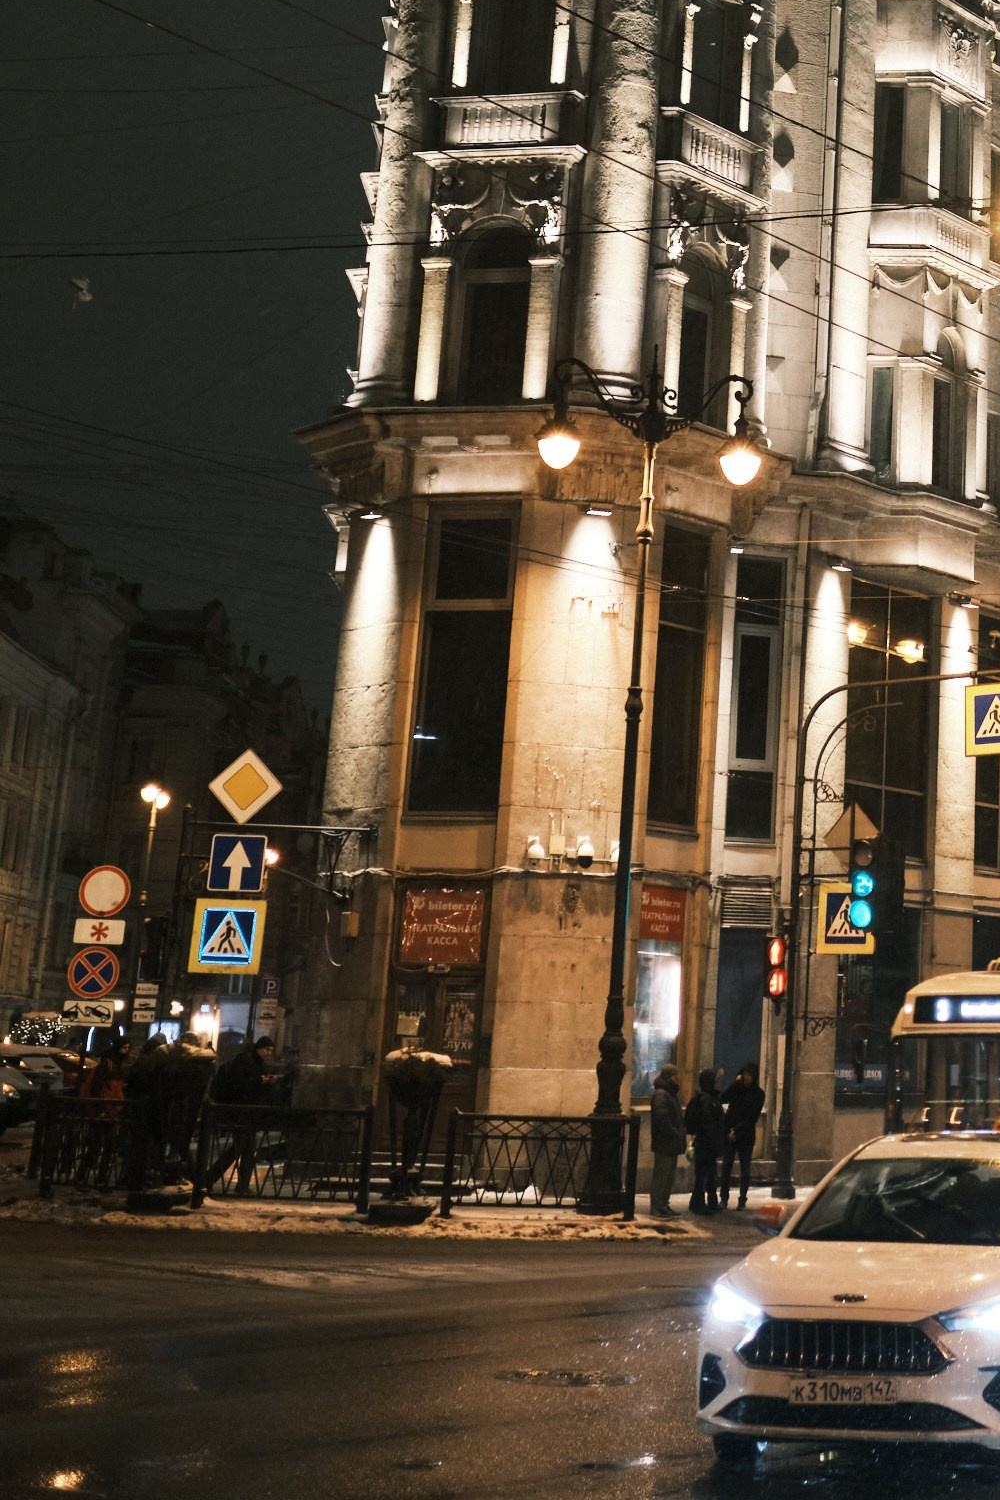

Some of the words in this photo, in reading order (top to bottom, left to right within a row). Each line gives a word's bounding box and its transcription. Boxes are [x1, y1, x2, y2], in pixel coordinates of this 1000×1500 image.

[856, 875, 873, 893] 24
[641, 911, 681, 922] ТЕАТРАЛЬНАЯ
[650, 924, 670, 933] КАССА
[426, 936, 459, 946] КАССА
[265, 980, 277, 994] P
[867, 1379, 893, 1396] 147
